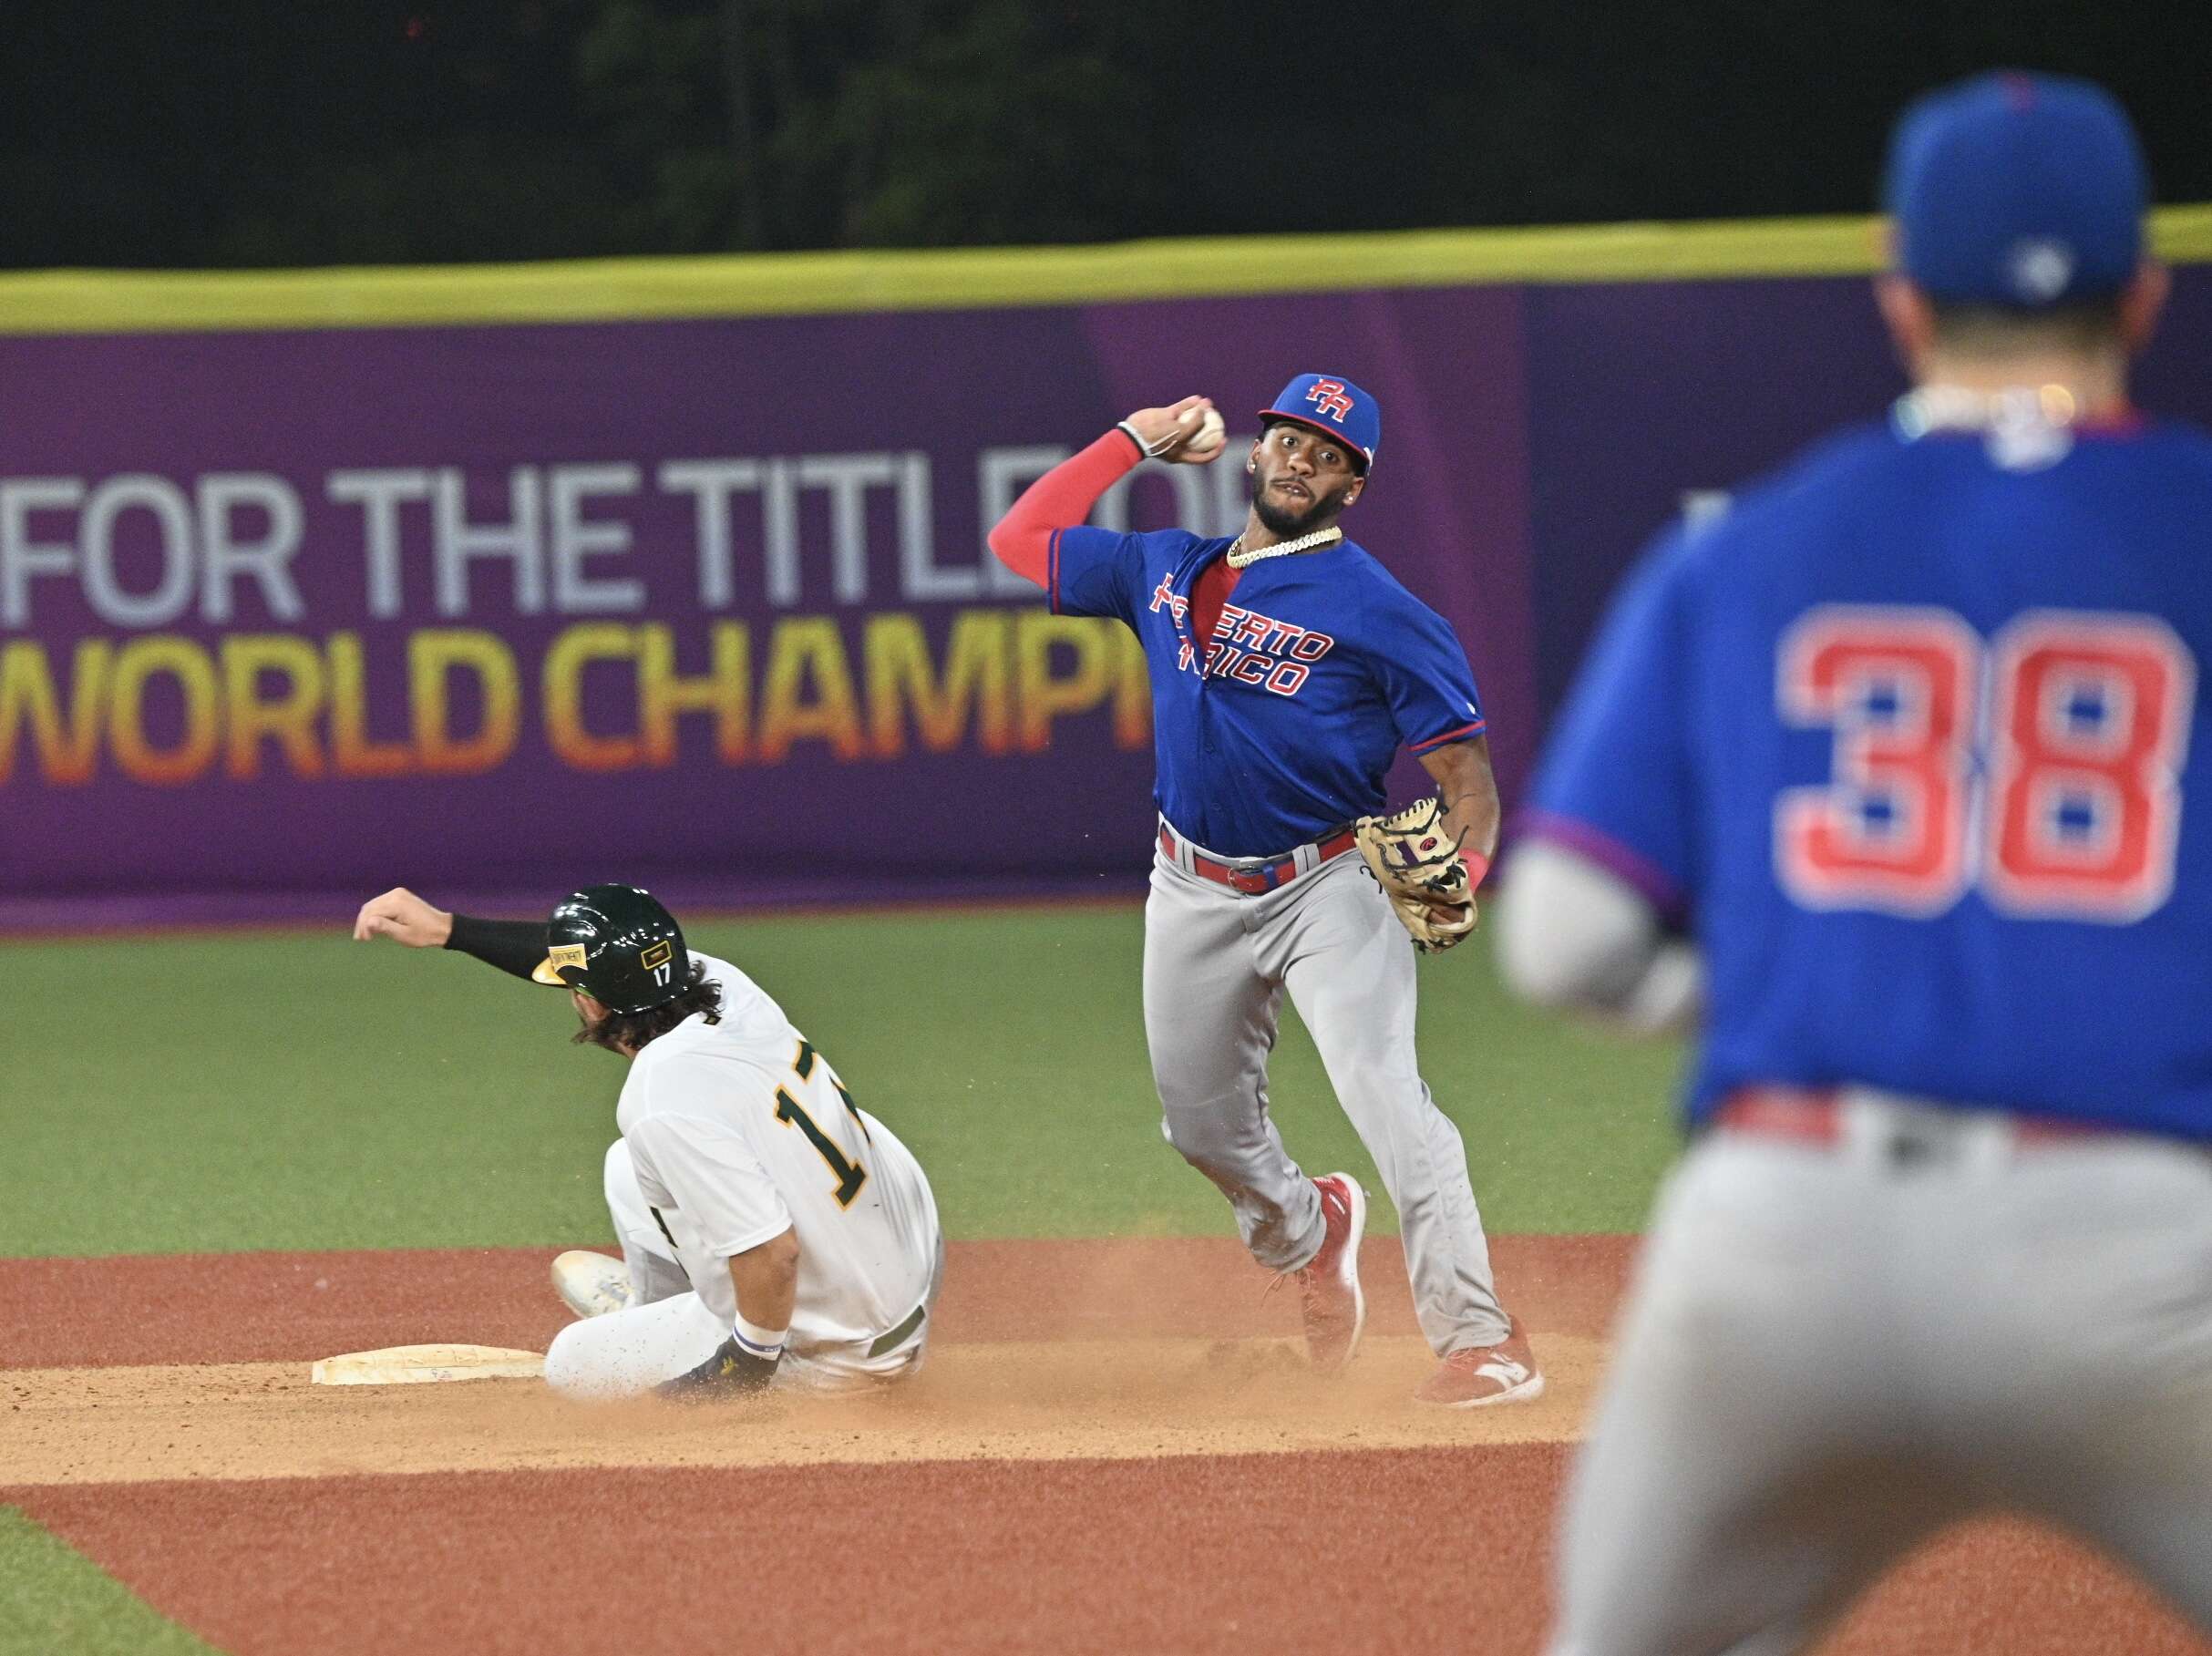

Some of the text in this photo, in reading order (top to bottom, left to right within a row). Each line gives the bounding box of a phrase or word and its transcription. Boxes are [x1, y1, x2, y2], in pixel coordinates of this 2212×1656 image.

[1305, 378, 1355, 423] PR
[0, 470, 306, 627] FOR
[327, 466, 643, 620] THE
[658, 448, 1074, 602] TITLE
[541, 611, 1150, 771] CHAMPI
[1775, 602, 2197, 926] 38
[653, 962, 671, 987] 17
